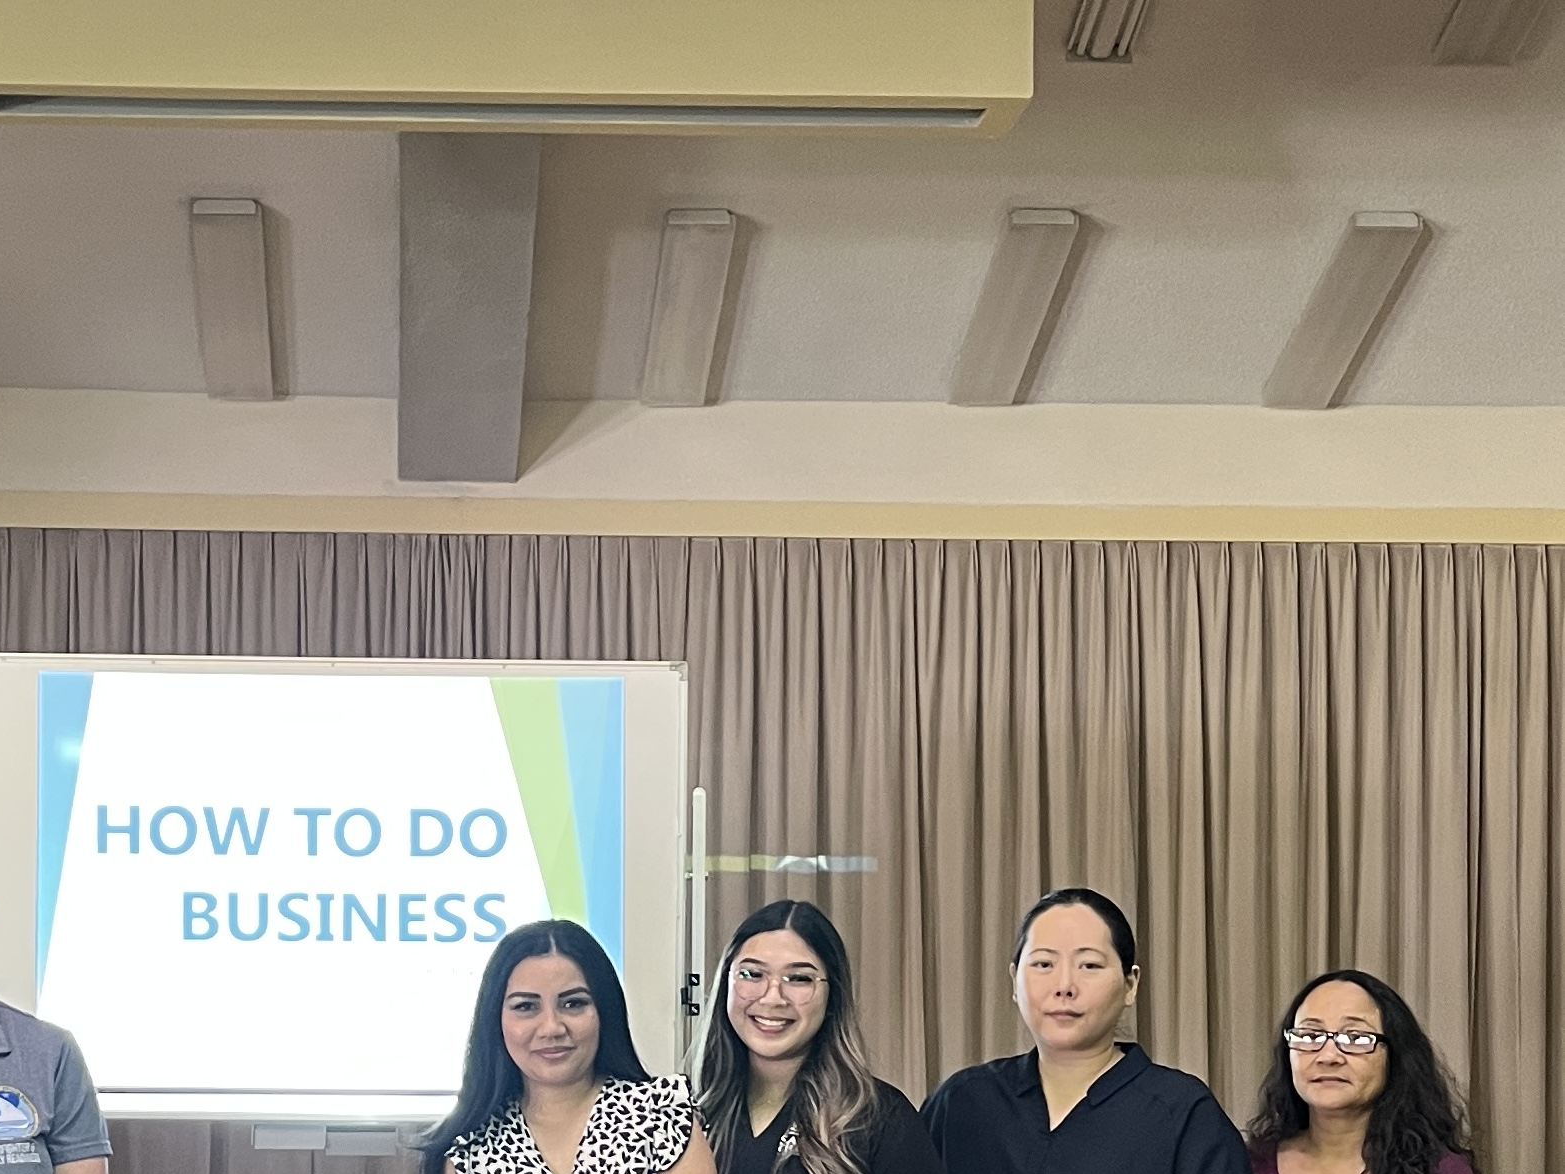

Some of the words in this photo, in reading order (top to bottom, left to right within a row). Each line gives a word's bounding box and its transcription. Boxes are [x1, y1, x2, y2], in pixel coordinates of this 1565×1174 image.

[96, 805, 270, 856] HOW
[294, 807, 383, 857] TO
[409, 808, 509, 858] DO
[183, 891, 508, 943] BUSINESS
